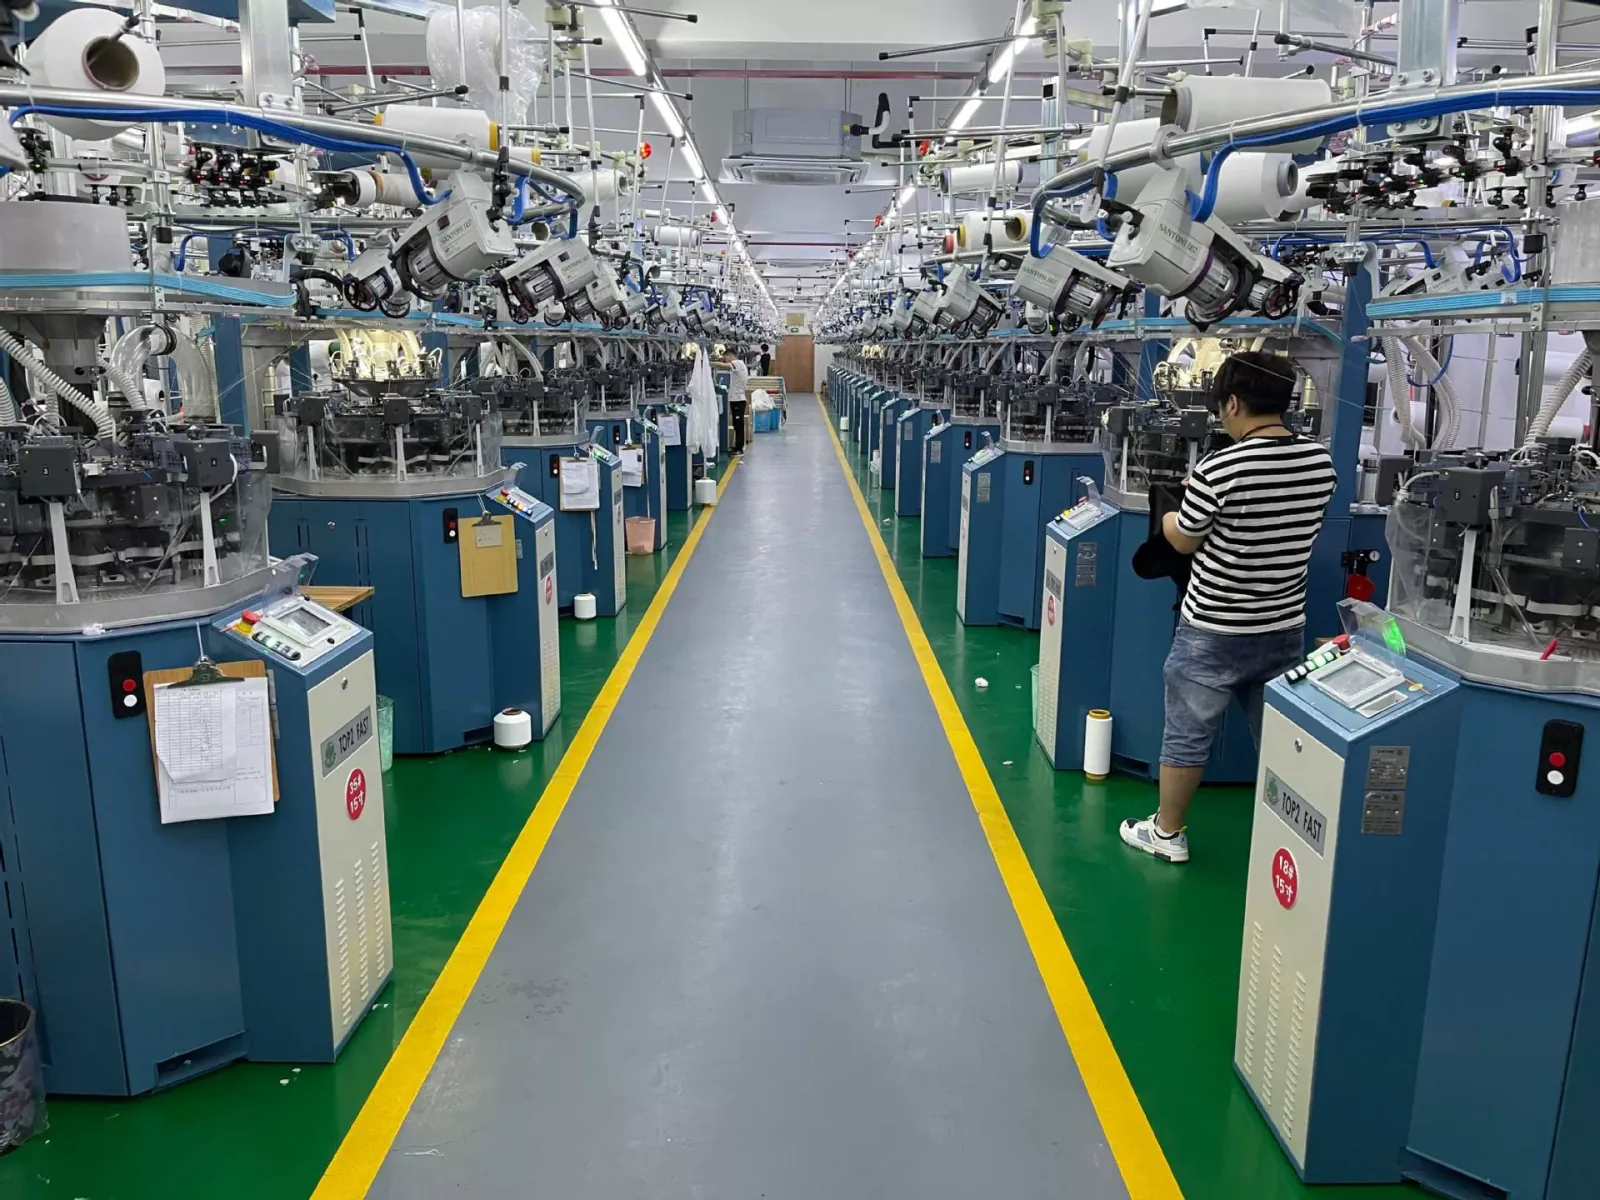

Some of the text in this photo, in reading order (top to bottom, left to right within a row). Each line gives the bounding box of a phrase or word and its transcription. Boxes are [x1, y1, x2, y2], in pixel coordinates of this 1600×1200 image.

[1160, 223, 1188, 247] SANTONI
[338, 716, 370, 754] TOP2 FAST
[1282, 791, 1300, 824] TOP2
[1303, 811, 1322, 842] FAST
